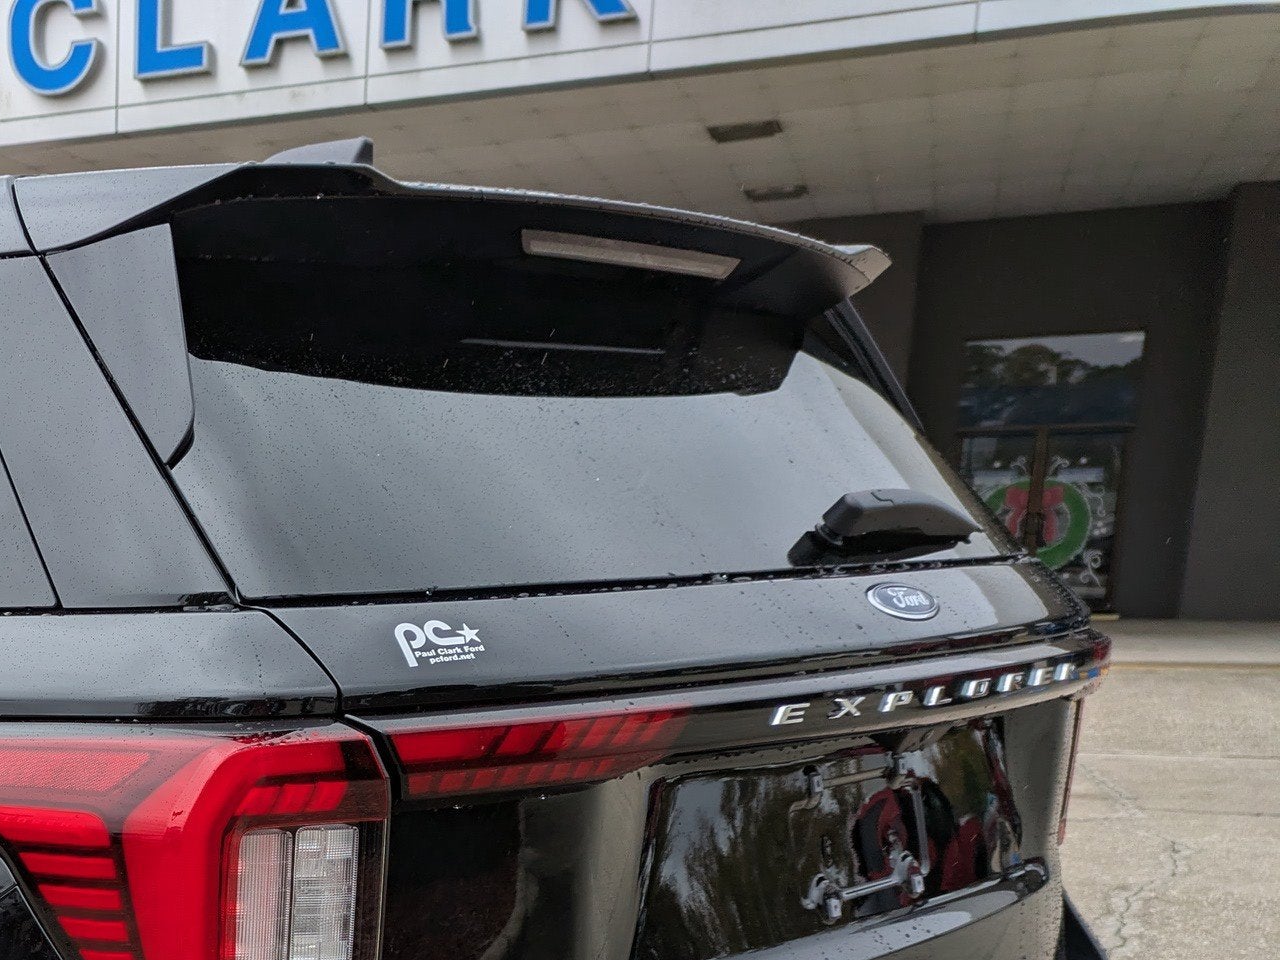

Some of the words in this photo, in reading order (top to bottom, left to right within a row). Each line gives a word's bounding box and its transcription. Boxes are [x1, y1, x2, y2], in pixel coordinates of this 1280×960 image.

[7, 0, 639, 97] CLA
[886, 587, 930, 608] Ford
[414, 648, 437, 659] Paul
[437, 646, 463, 656] Clark
[463, 644, 486, 654] Ford
[429, 652, 476, 665] pcford.net
